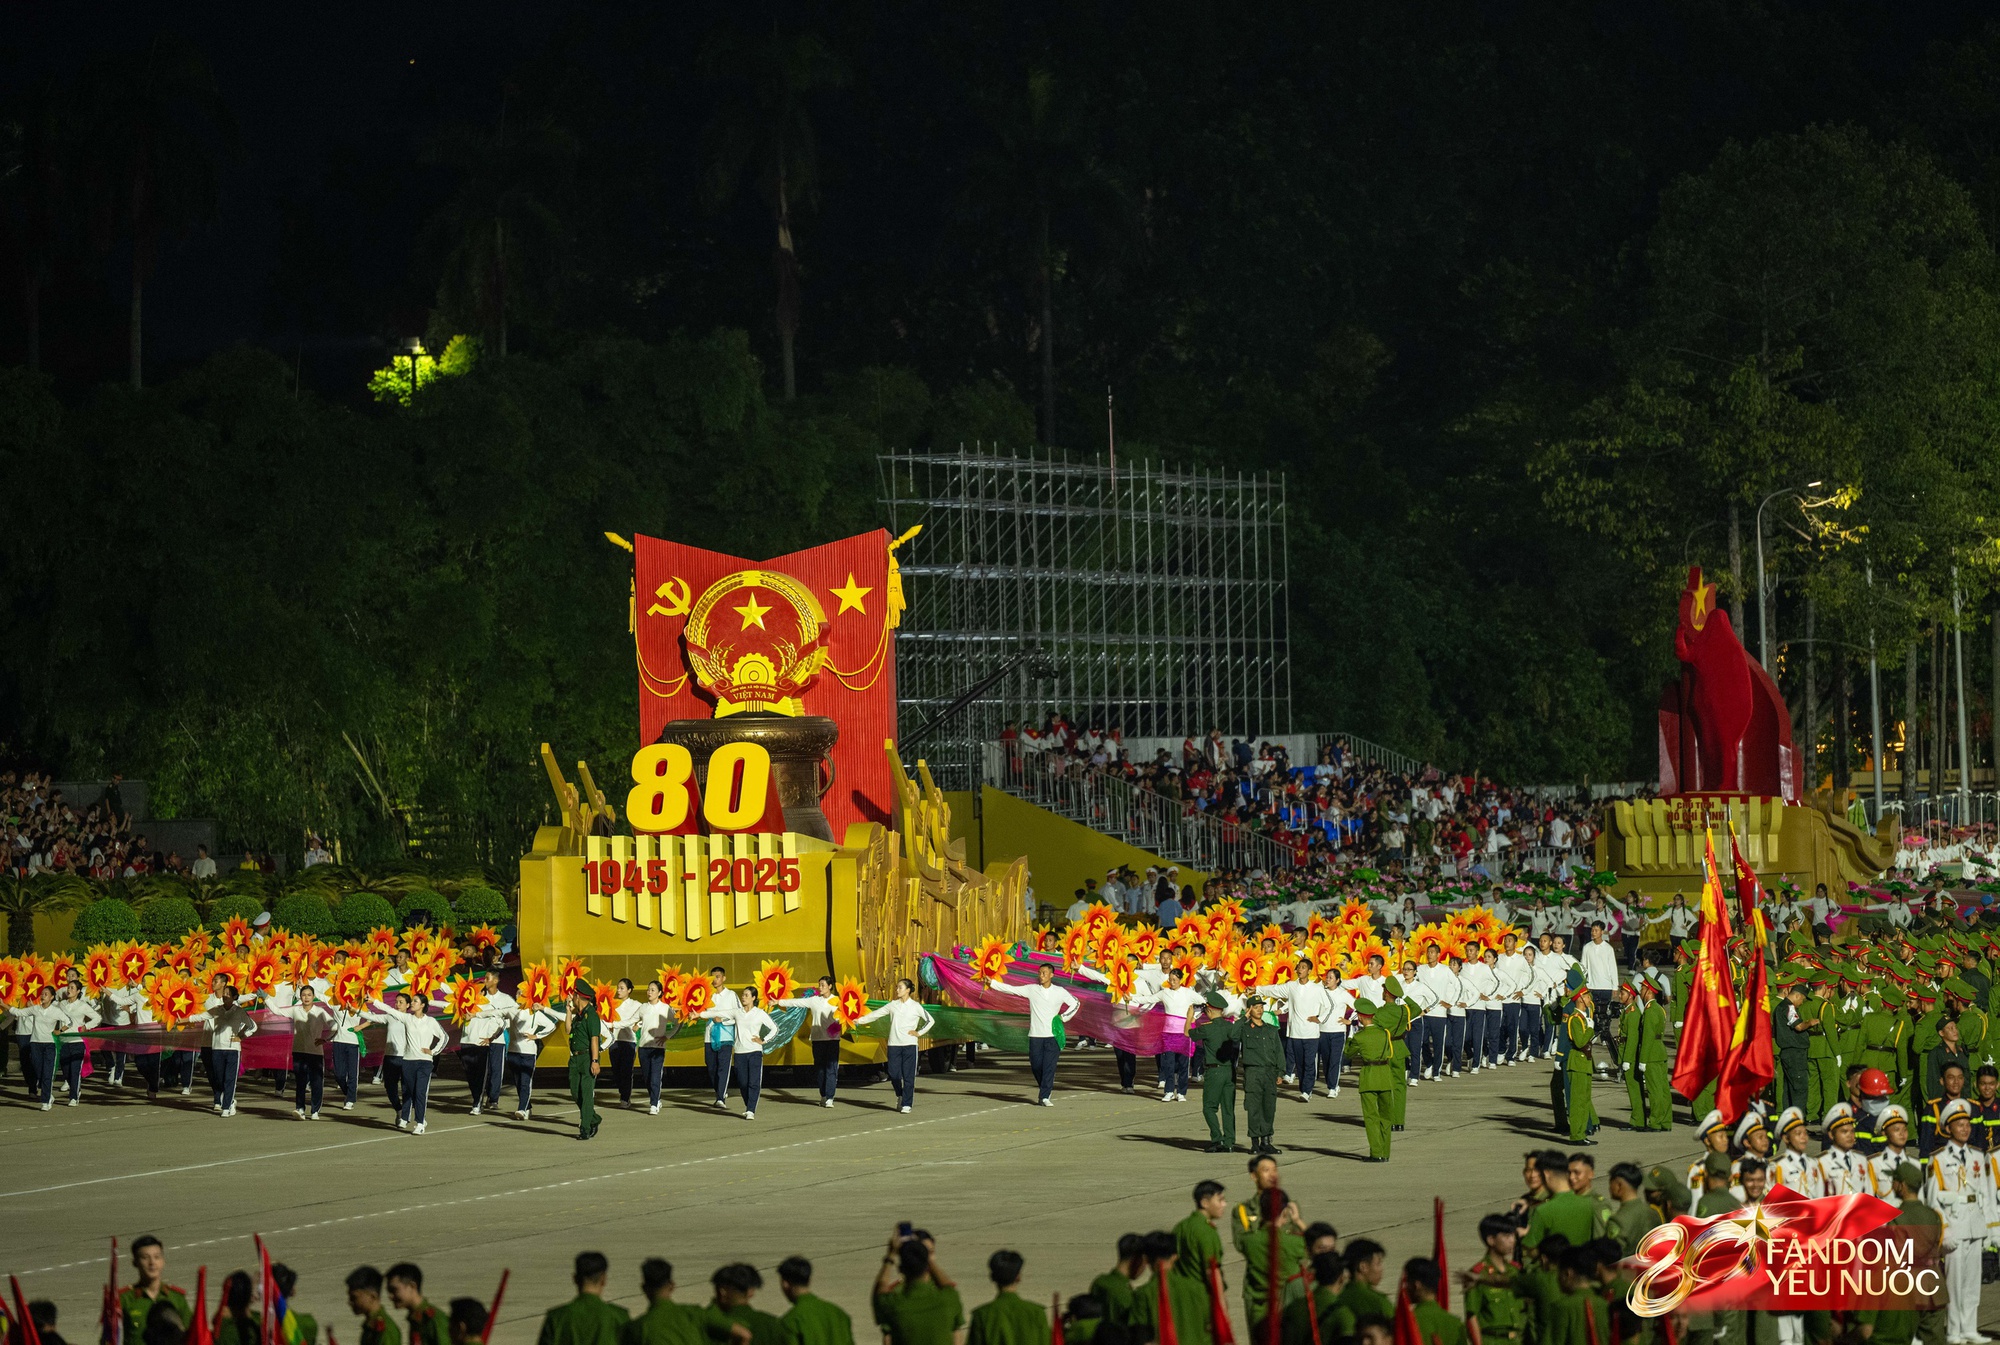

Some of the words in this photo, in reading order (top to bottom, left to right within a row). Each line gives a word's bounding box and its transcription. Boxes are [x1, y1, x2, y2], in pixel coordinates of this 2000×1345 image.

[733, 690, 752, 700] VIỆT
[755, 691, 775, 700] NAM
[626, 742, 770, 832] 80
[584, 859, 668, 894] 1945
[683, 872, 696, 880] -
[709, 858, 800, 893] 2025
